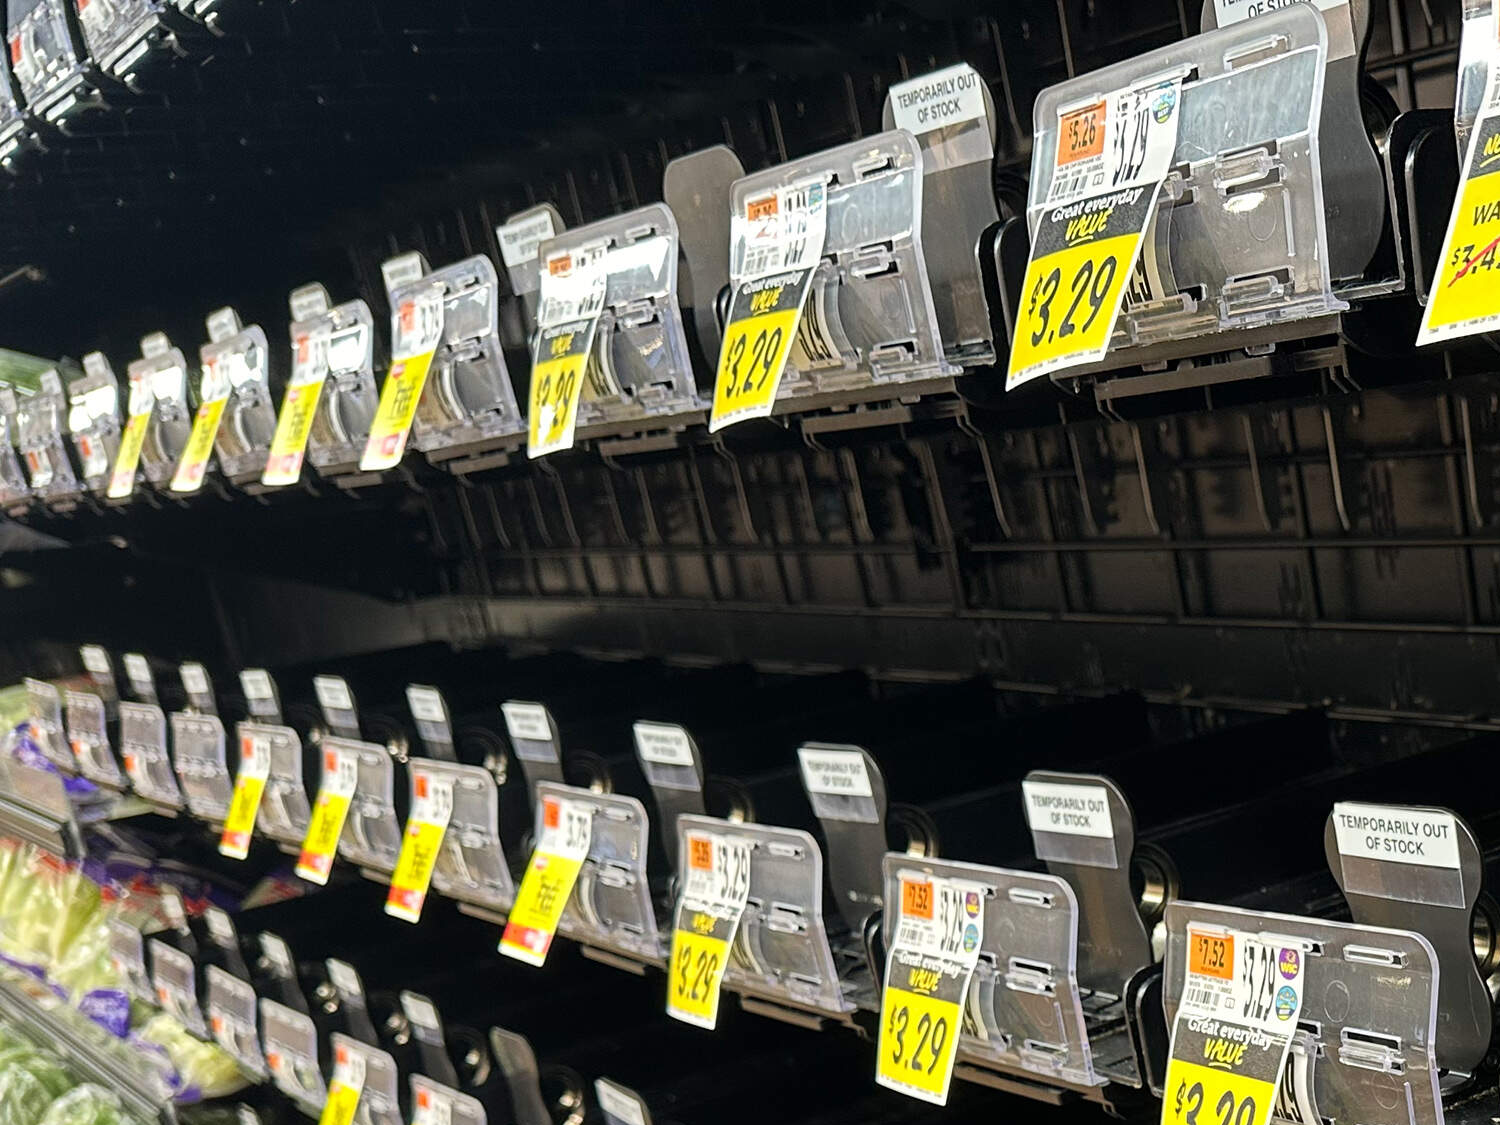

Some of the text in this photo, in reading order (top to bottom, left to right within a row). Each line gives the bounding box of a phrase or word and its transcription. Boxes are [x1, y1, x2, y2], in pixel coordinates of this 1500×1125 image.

[897, 72, 977, 109] TEMPORARILY OUT
[917, 98, 962, 124] OF STOCK
[1068, 112, 1096, 151] $5.26
[1051, 187, 1144, 223] Great everyday
[1065, 207, 1114, 241] VALUE
[1029, 254, 1118, 348] $3.29
[1340, 814, 1449, 839] TEMPORARILY OUT
[1365, 836, 1425, 856] OF STOCK
[1199, 938, 1225, 968] $7.52
[888, 1003, 949, 1077] $3.29
[1188, 1017, 1272, 1051] Great everyday
[1204, 1037, 1248, 1066] VALUE
